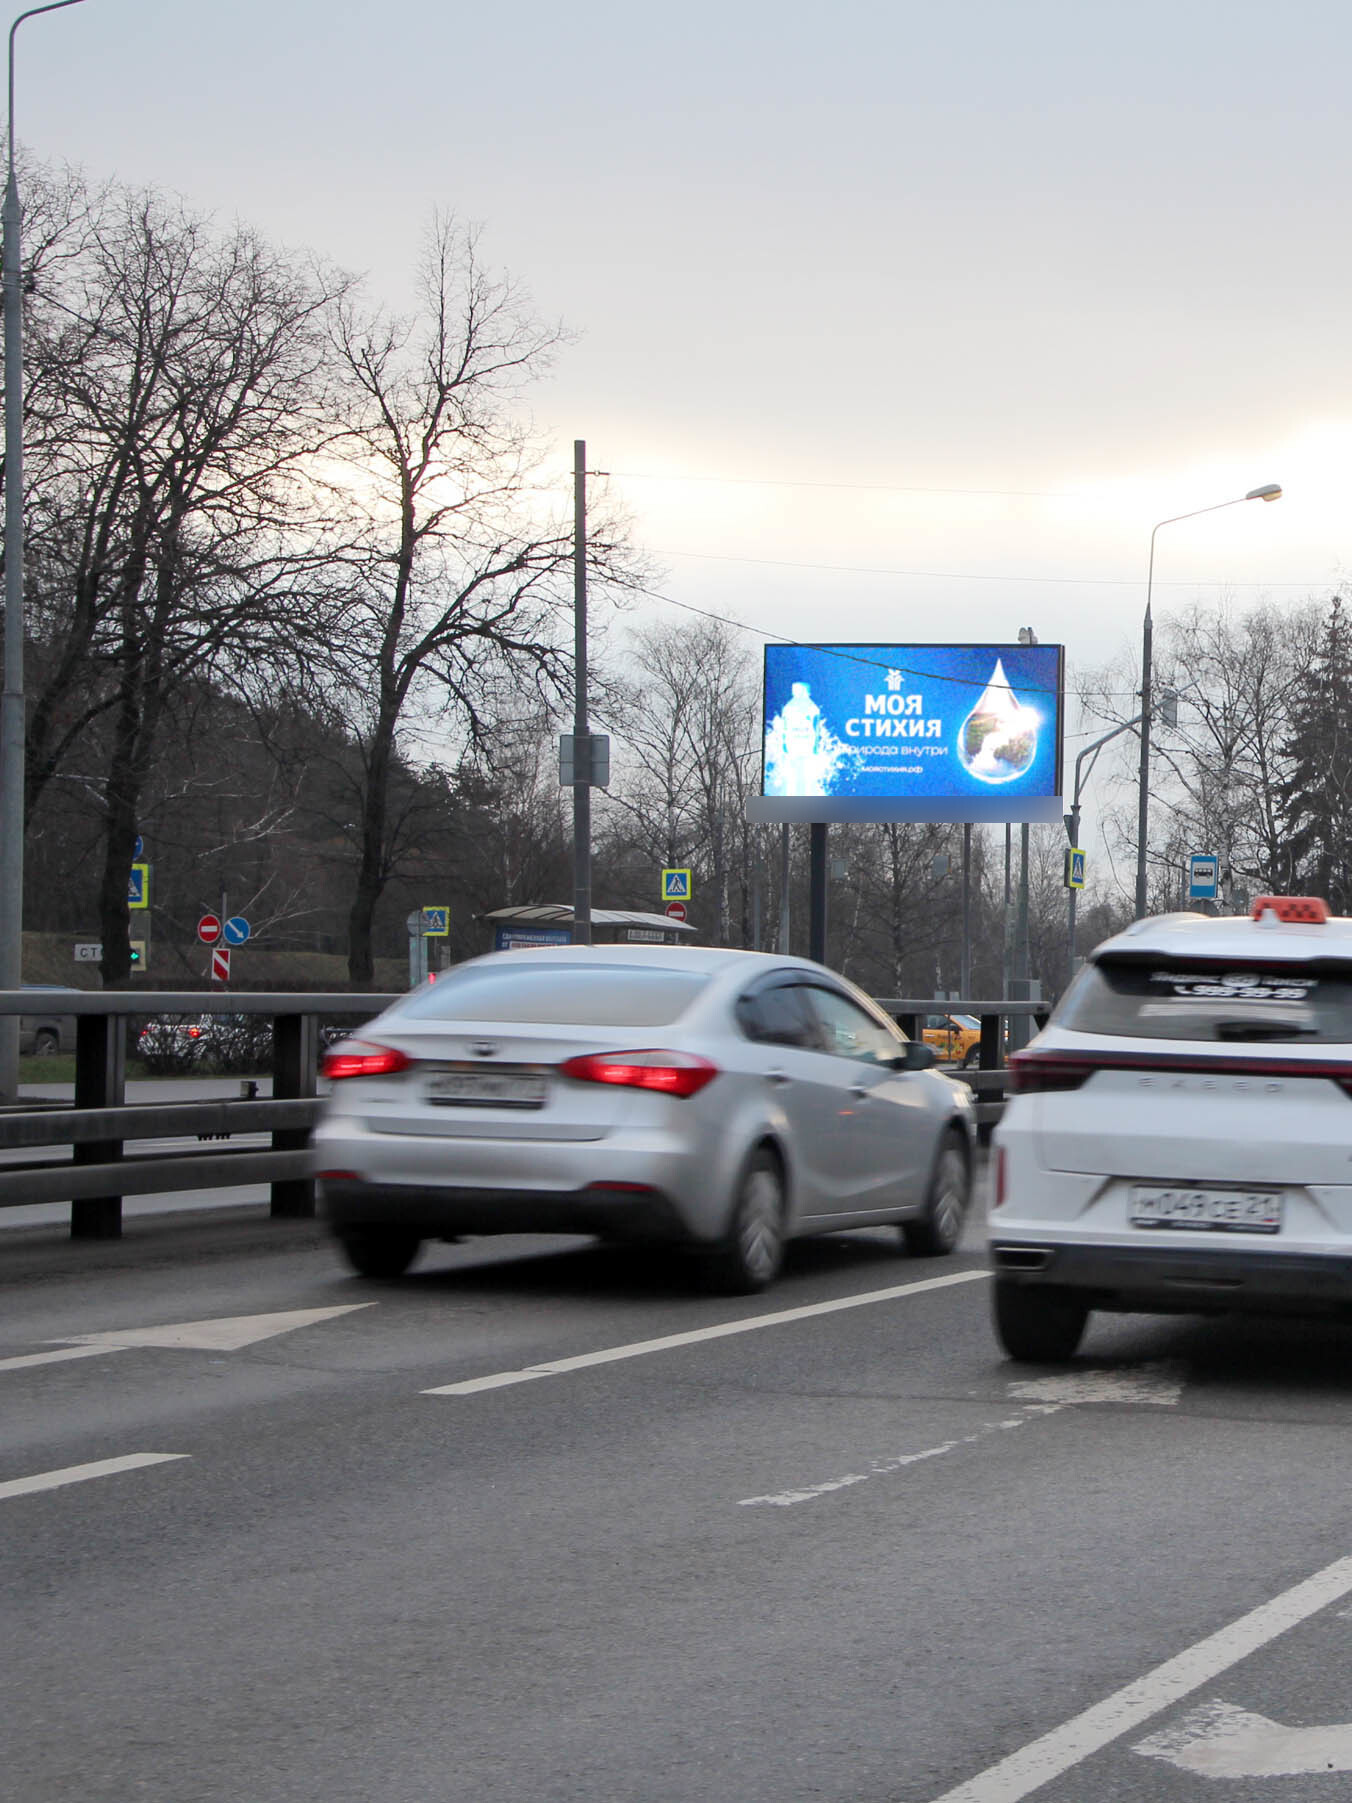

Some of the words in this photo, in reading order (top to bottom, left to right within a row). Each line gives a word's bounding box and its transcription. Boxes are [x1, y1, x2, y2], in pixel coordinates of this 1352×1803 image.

[865, 695, 922, 715] МОЯ
[845, 719, 941, 737] СТИХИЯ
[838, 745, 898, 757] рирода
[901, 745, 949, 757] внутри
